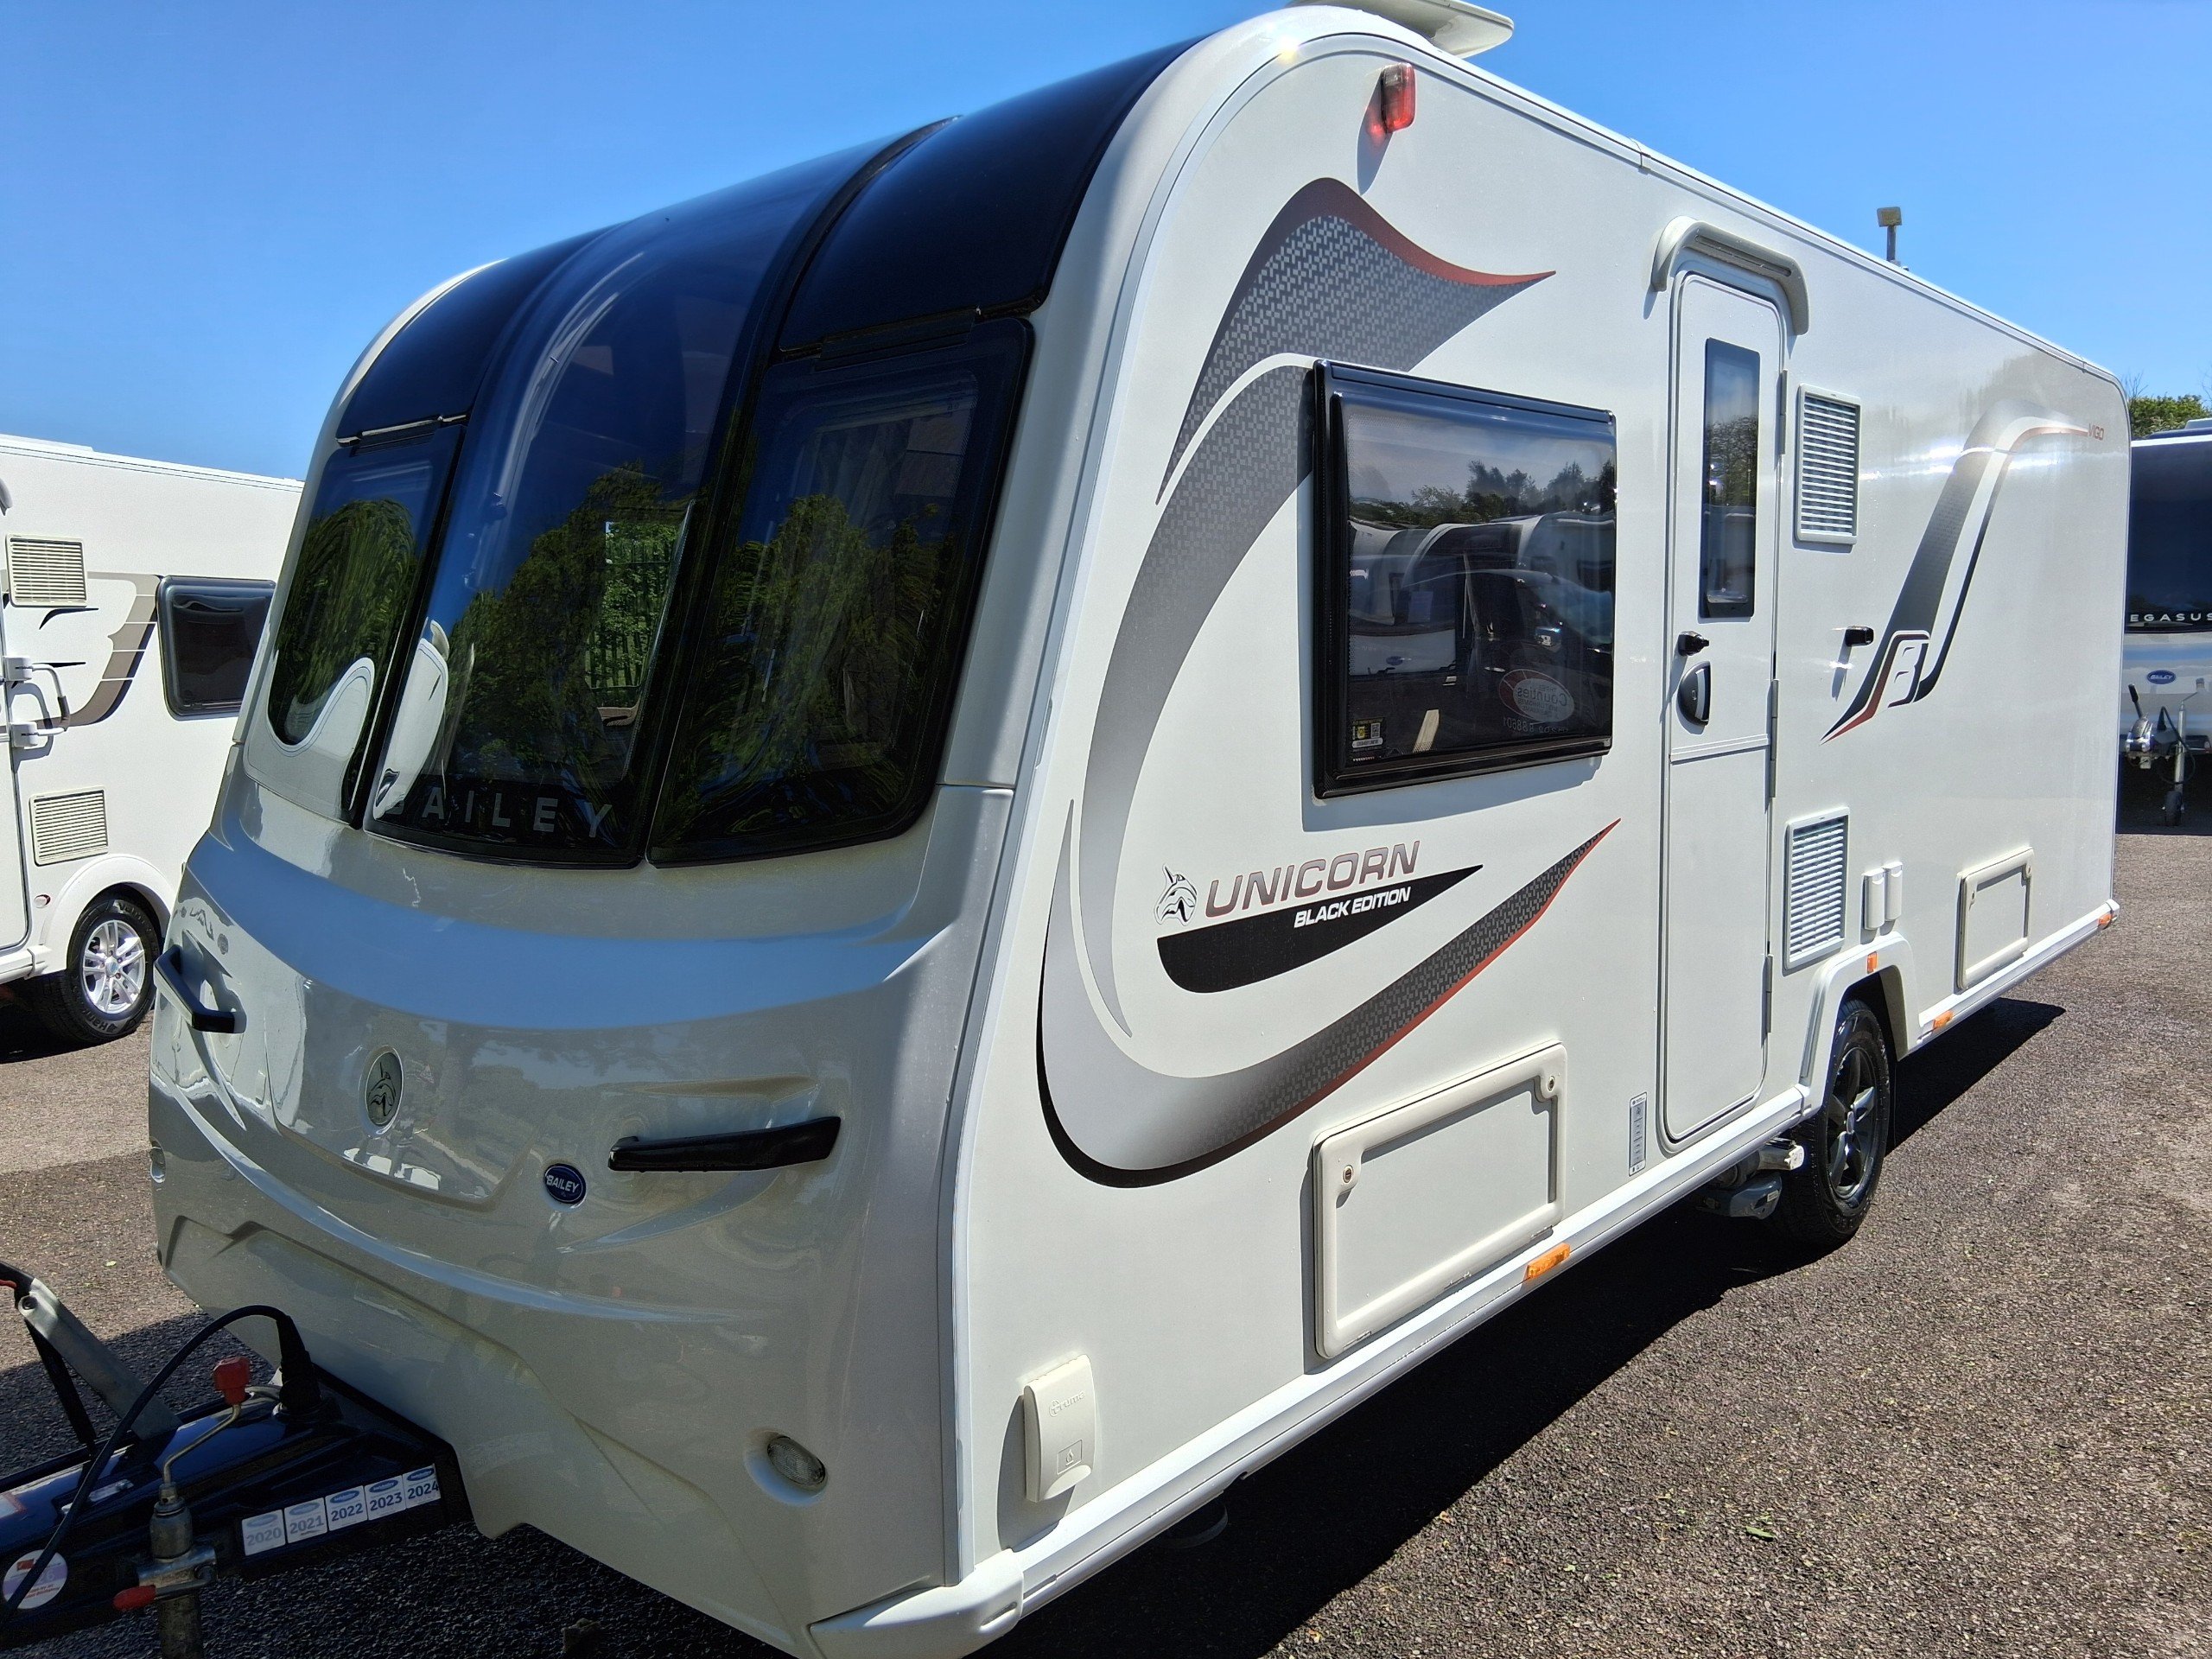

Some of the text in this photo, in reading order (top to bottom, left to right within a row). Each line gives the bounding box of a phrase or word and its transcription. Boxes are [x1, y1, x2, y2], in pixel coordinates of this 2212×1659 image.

[2130, 613, 2212, 622] EGASUS
[1205, 841, 1421, 918] UNICORN
[1294, 887, 1412, 929] BLACK EDITION
[546, 1175, 579, 1193] BAILEY
[407, 1480, 439, 1500] 2024
[369, 1491, 404, 1512] 2023
[330, 1503, 364, 1522] 2022
[289, 1515, 324, 1535] 2021
[246, 1527, 283, 1547] 2020
